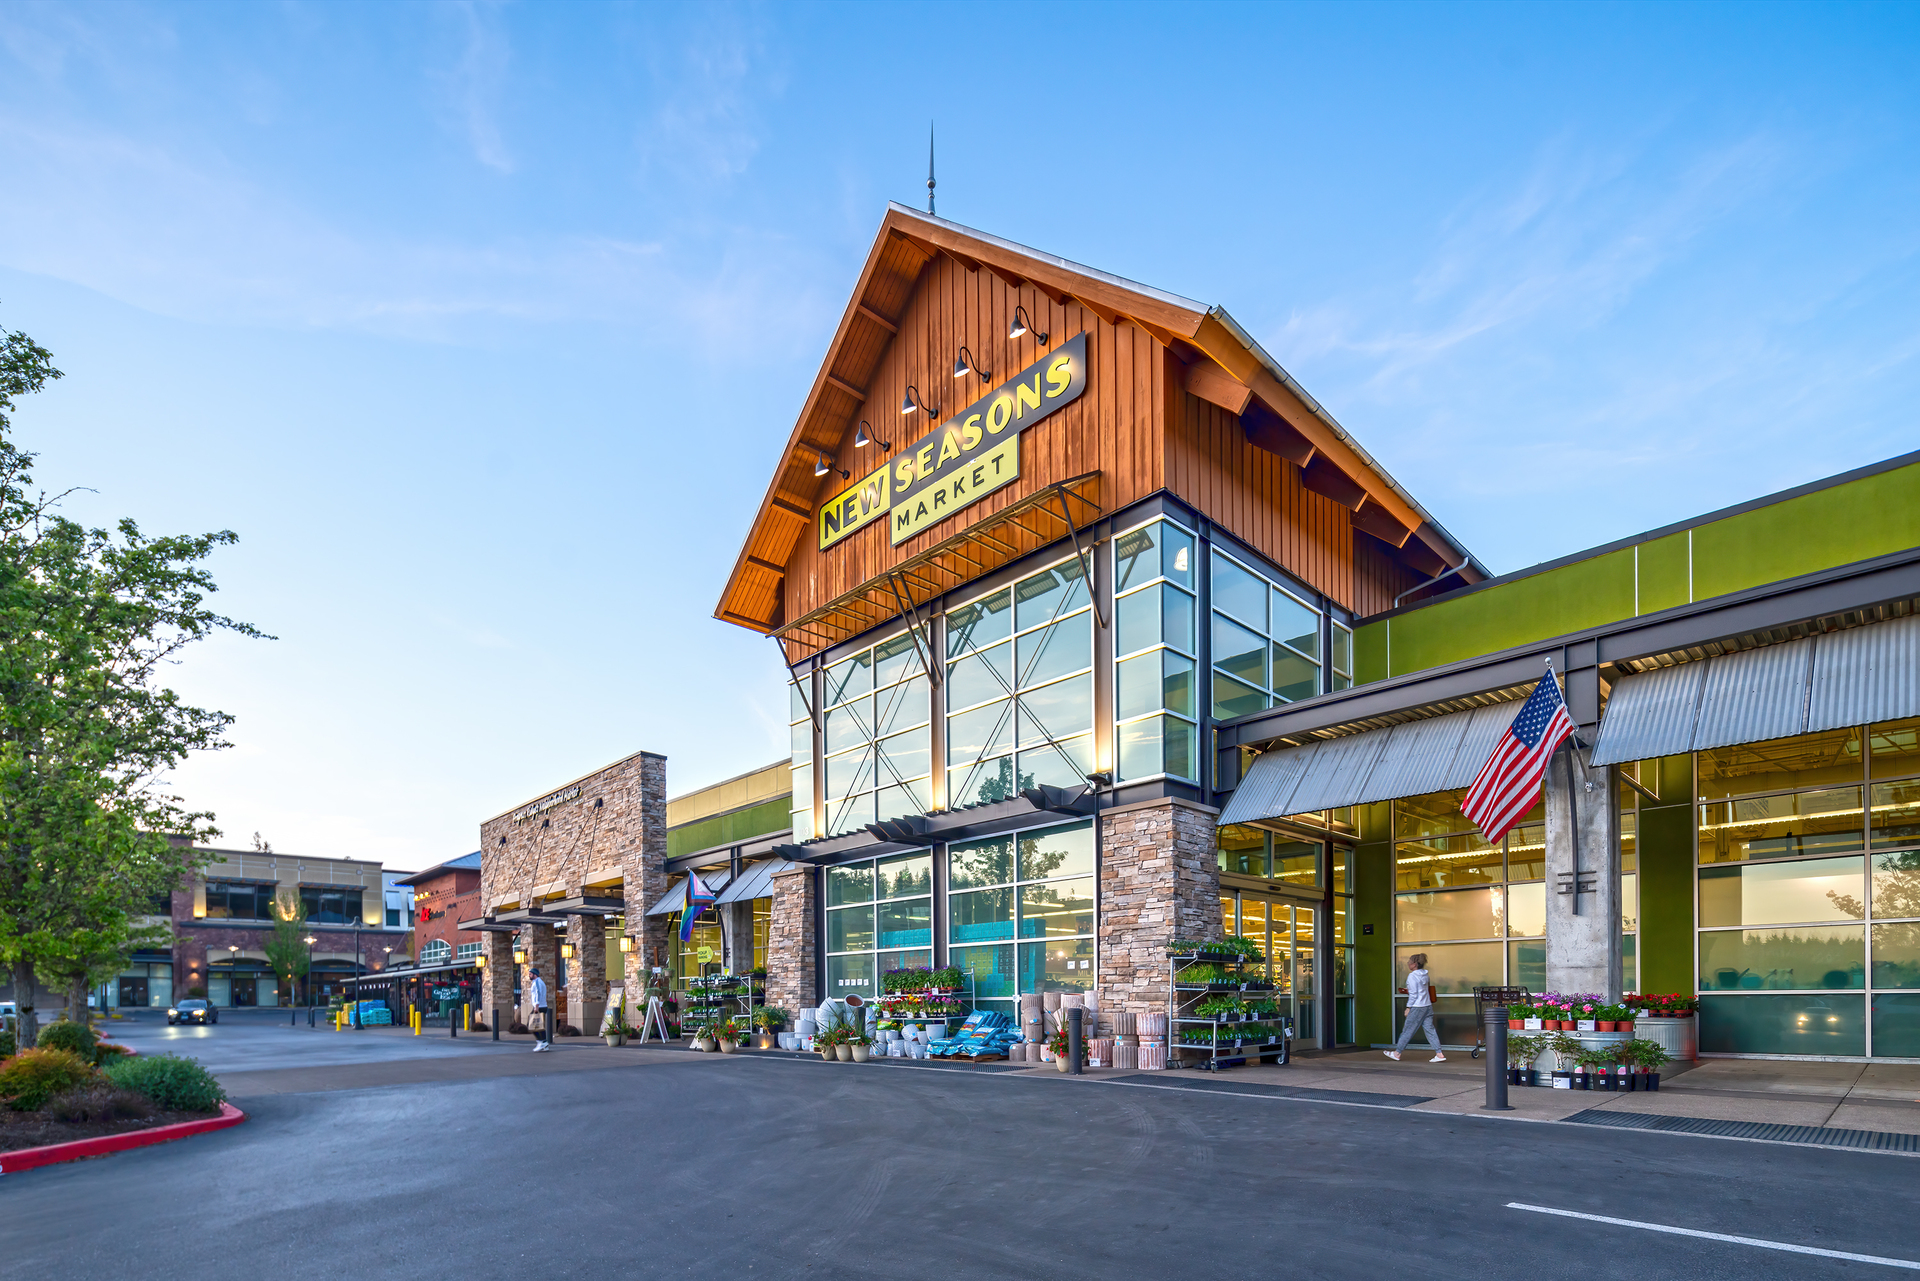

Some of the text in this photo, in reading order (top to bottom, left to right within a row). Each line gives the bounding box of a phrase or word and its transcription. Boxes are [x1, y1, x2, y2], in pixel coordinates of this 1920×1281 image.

[824, 357, 1072, 539] NEW SEASONS
[897, 453, 1005, 531] MARKET
